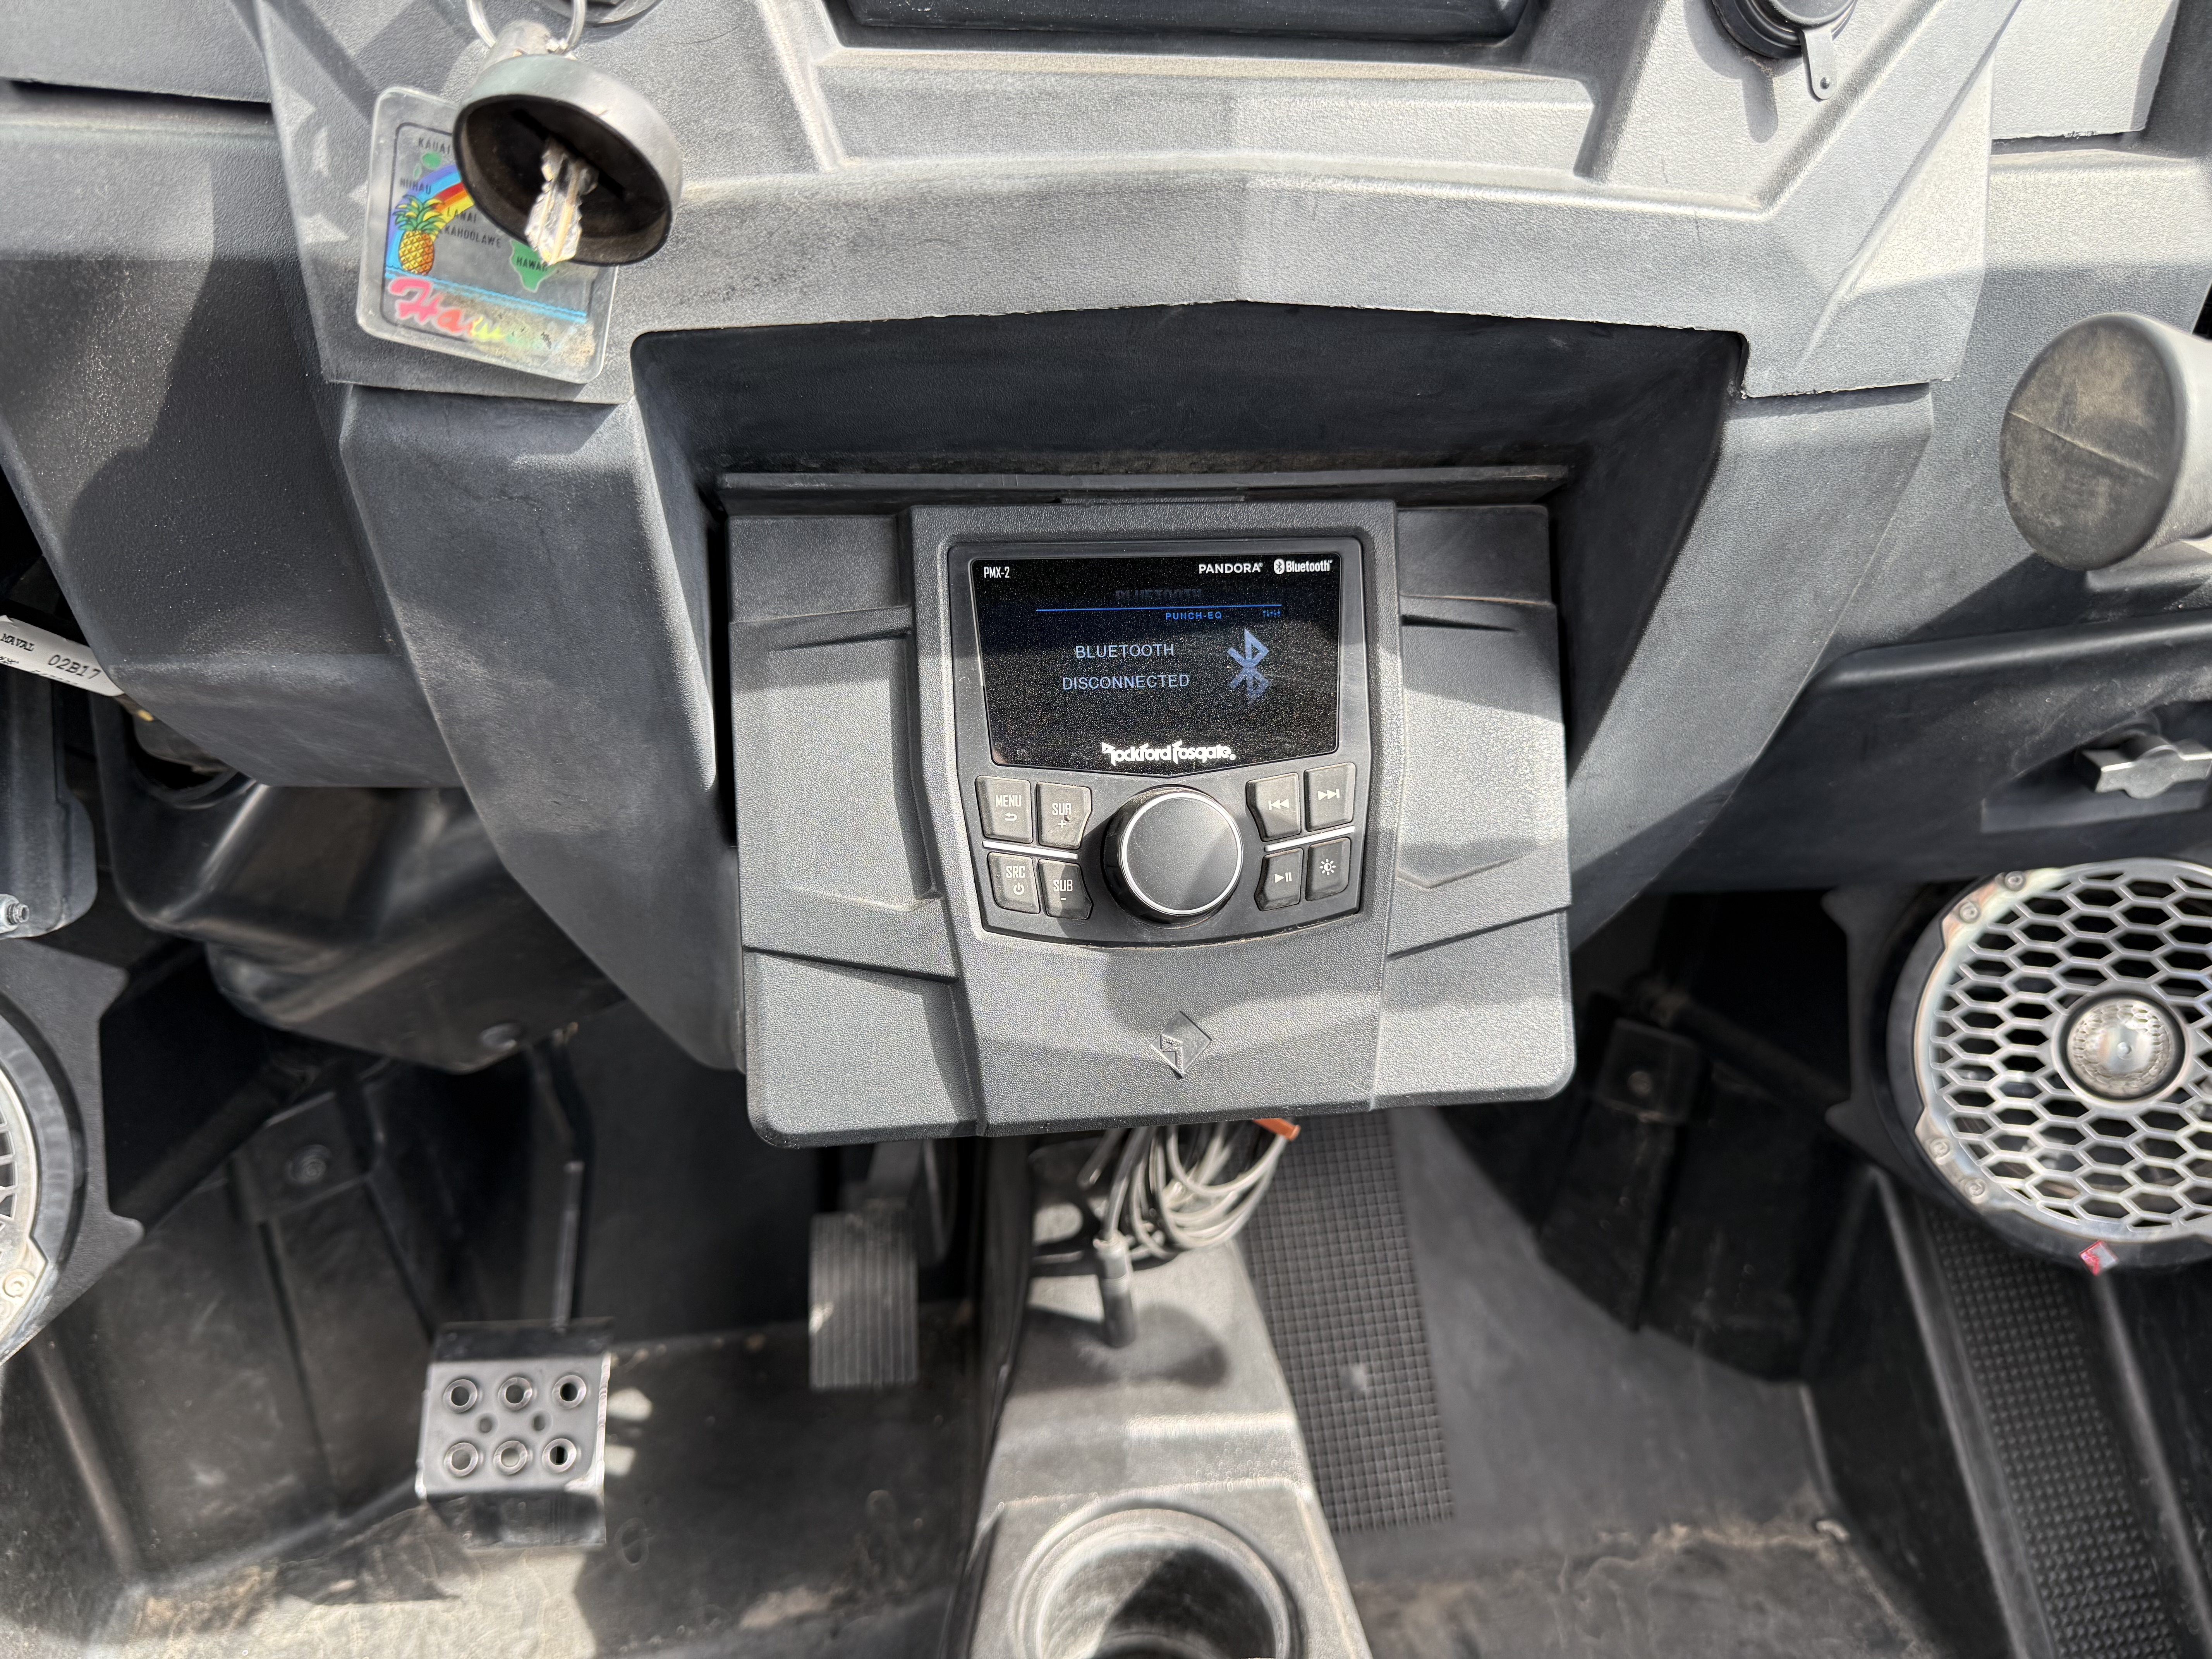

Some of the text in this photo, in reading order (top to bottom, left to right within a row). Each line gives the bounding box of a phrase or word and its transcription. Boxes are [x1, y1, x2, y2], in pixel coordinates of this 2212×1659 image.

[418, 137, 451, 155] KAUAI
[400, 177, 432, 194] NIIHAU
[445, 225, 502, 248] KAHOOLAWE
[984, 566, 1010, 578] PMX-2
[1286, 559, 1331, 572] Bluetooth
[1165, 611, 1222, 620] PUNCH-EQ
[0, 633, 35, 652] MAVAL
[1075, 644, 1175, 659] BLUETOOTH
[48, 654, 101, 679] 02B17
[1062, 675, 1190, 690] DISCONNECTED
[1101, 740, 1232, 766] Rockford Fosgate
[995, 795, 1022, 807] MENU
[1006, 866, 1025, 878] SRC
[1053, 879, 1073, 891] SUB
